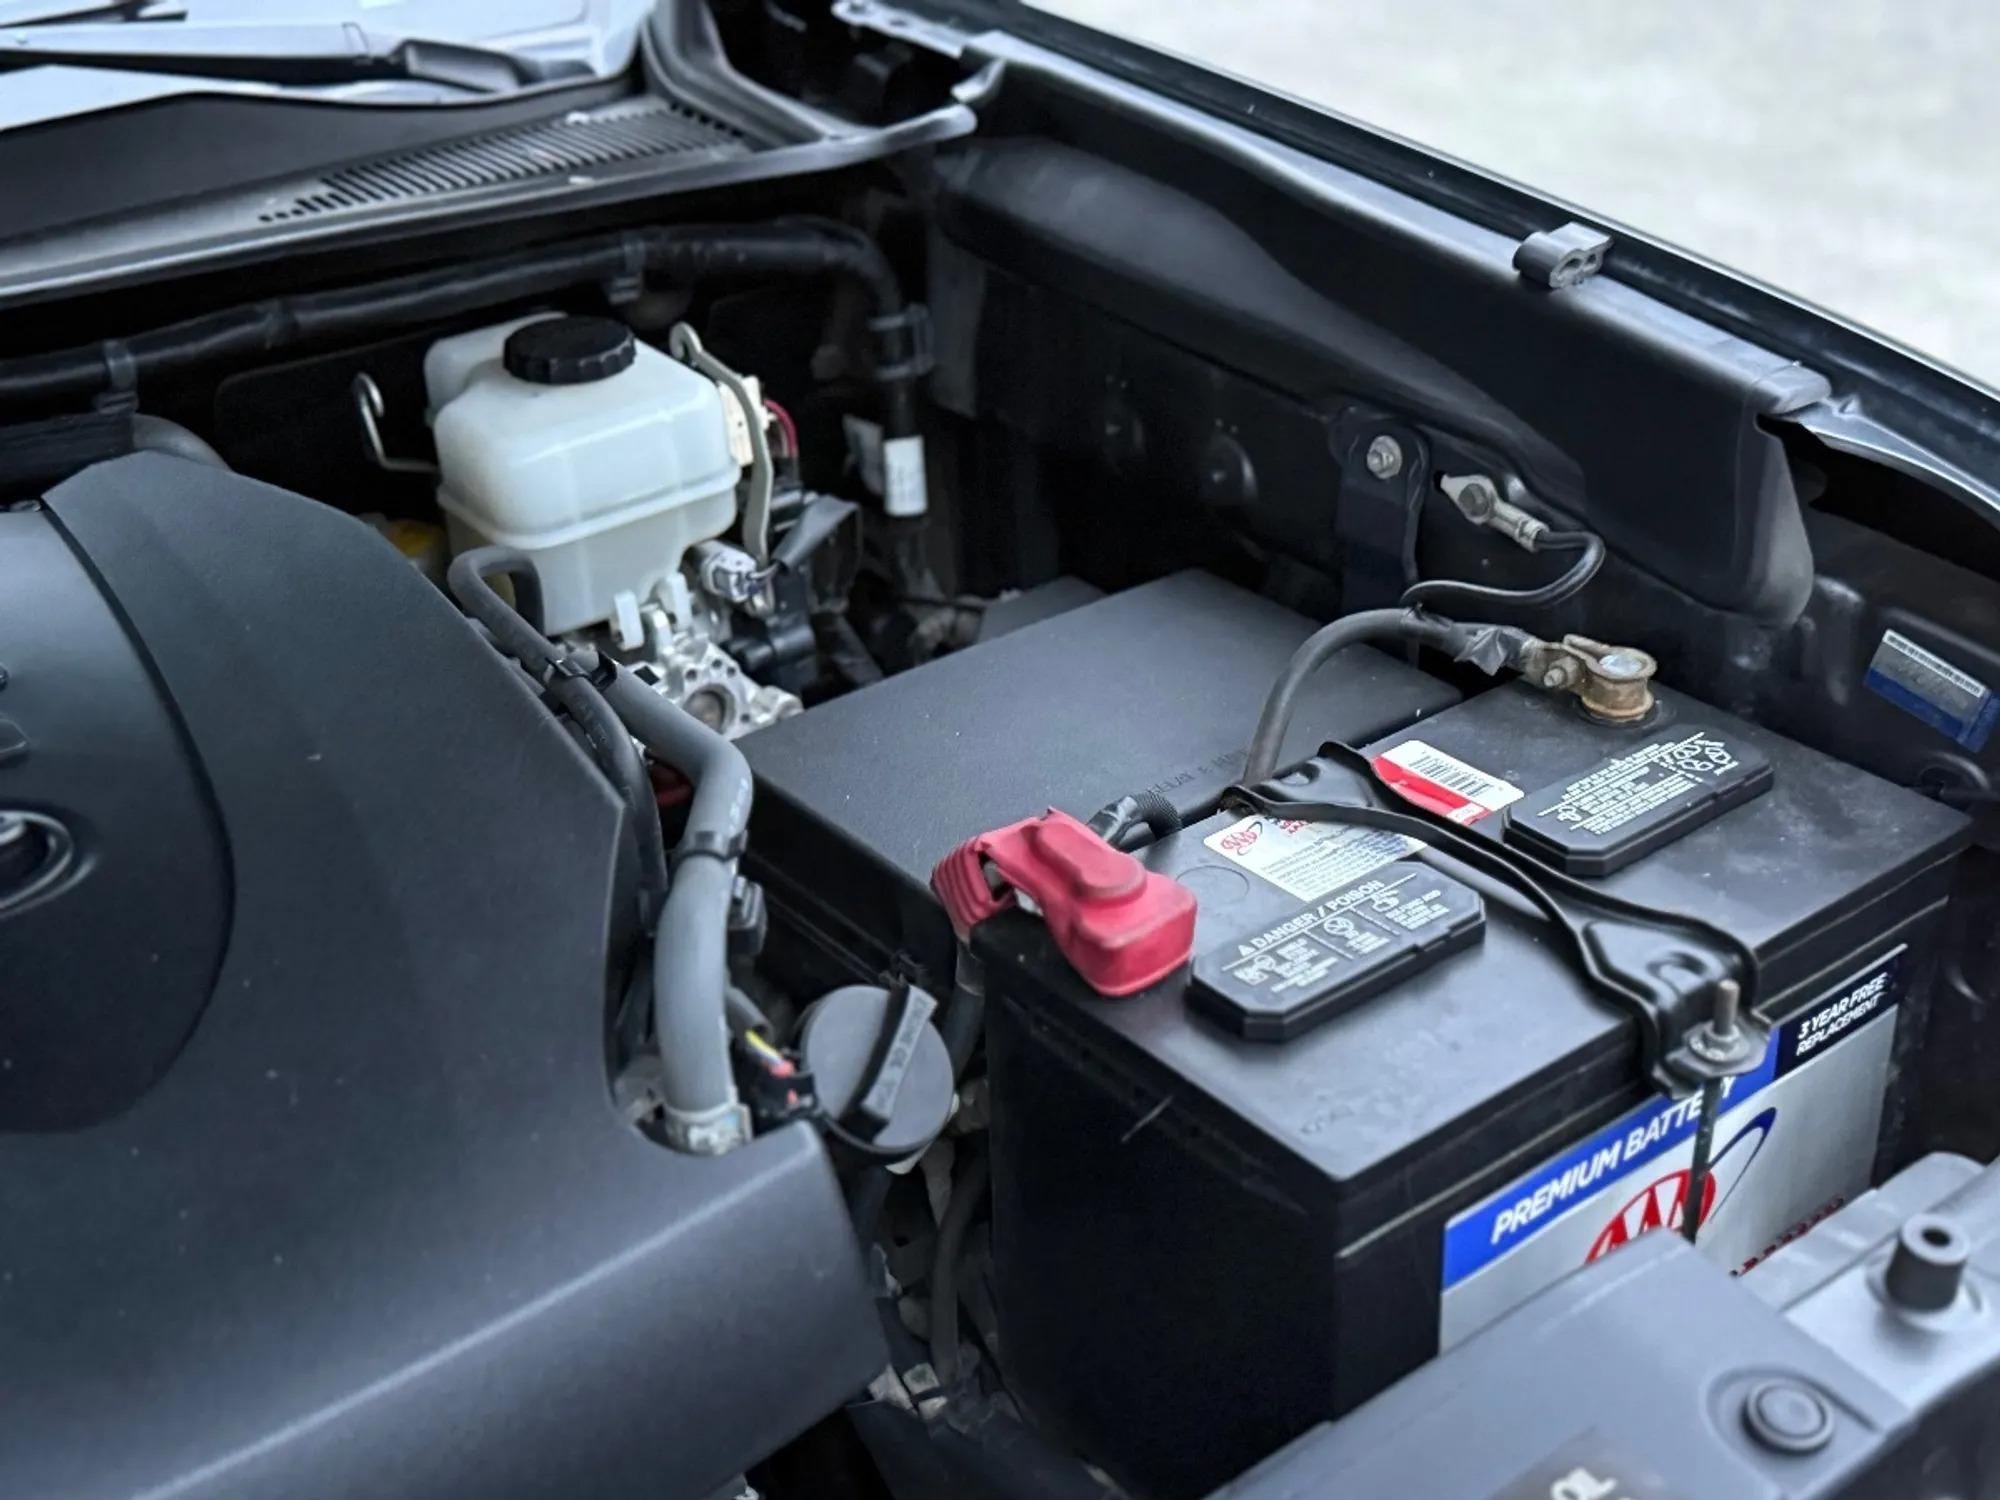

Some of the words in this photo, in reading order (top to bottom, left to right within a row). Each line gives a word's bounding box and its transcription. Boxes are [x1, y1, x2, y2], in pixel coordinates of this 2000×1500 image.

[1250, 912, 1318, 949] DANGER
[1325, 879, 1386, 911] POISON
[1796, 991, 1888, 1056] REPLACEMENT
[1798, 1019, 1811, 1040] 3
[1811, 996, 1850, 1032] YEAR
[1849, 971, 1888, 1008] FREE
[1490, 1139, 1623, 1245] PREMIUM
[1623, 1076, 1737, 1161] BATTEY
